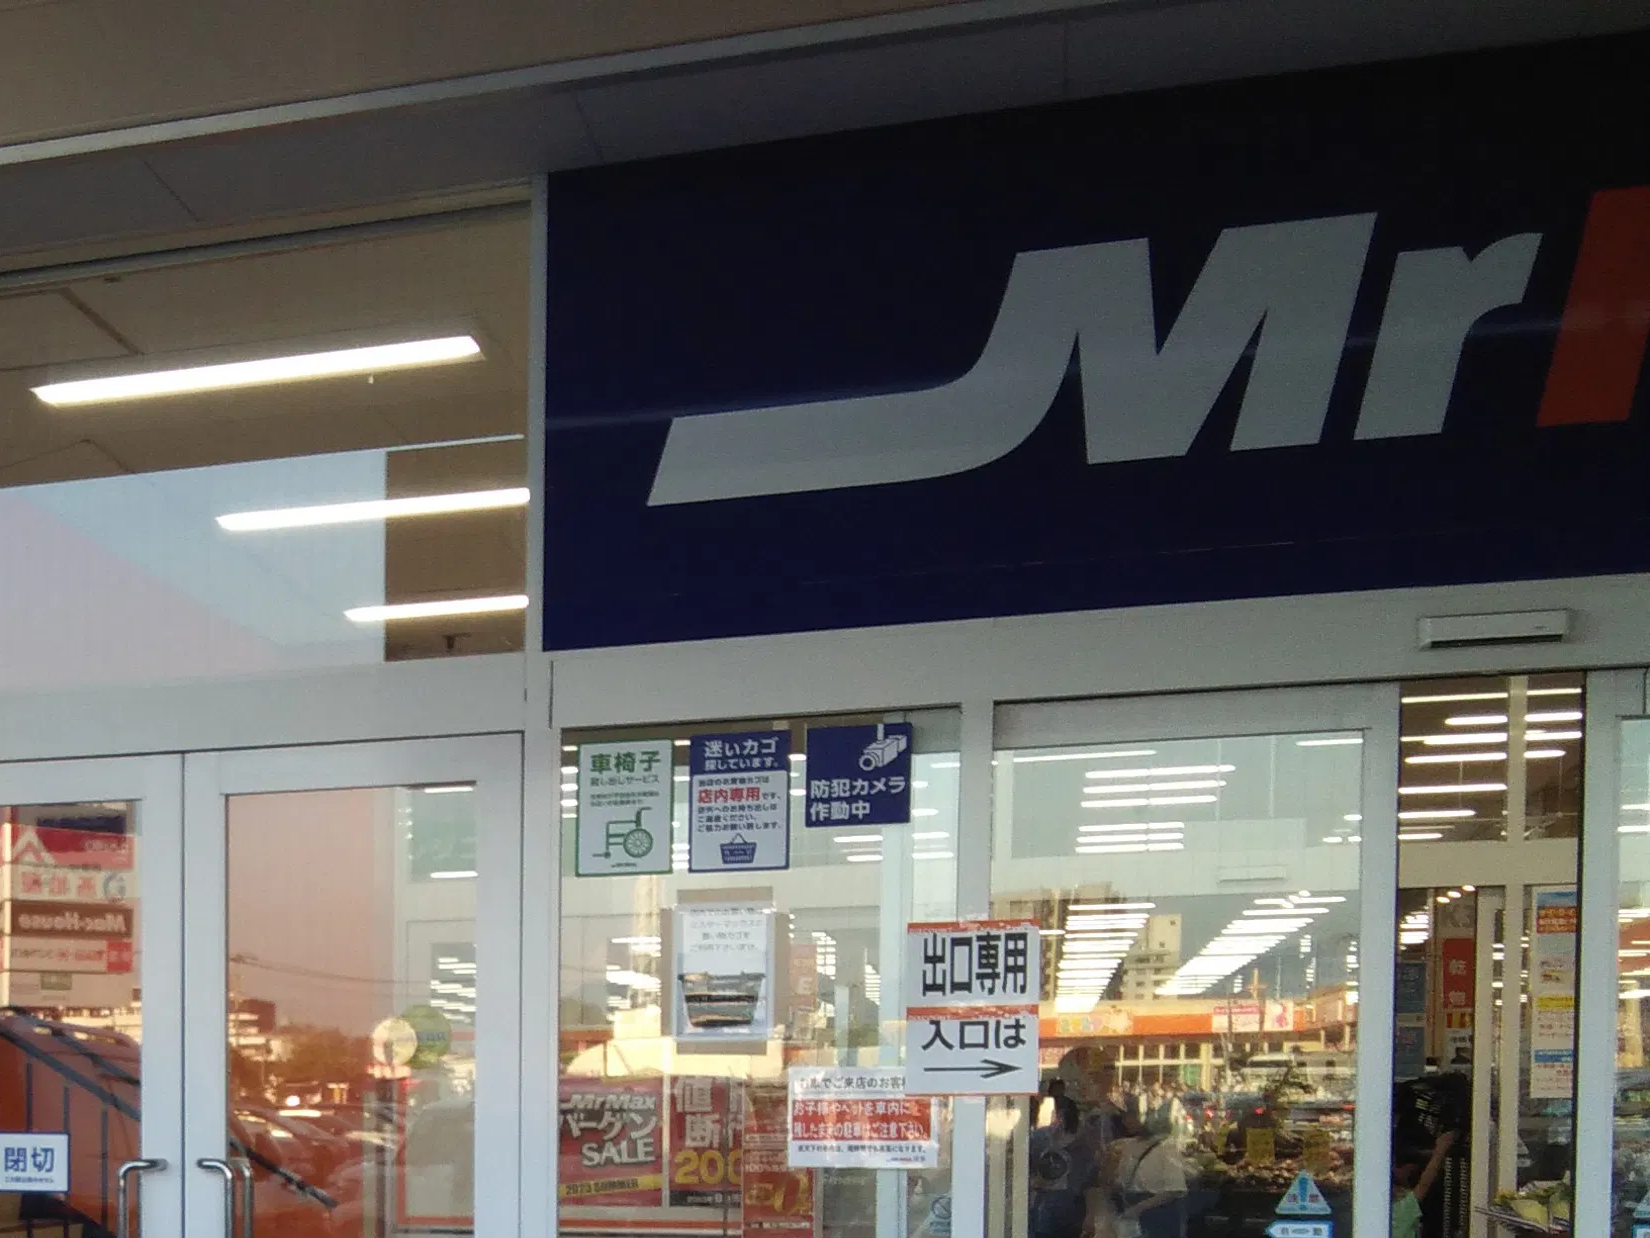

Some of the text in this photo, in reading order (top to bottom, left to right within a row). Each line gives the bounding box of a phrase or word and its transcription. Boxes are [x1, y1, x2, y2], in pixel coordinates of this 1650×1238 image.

[704, 737, 779, 758] 迷いカゴ
[590, 751, 661, 775] 車椅子
[810, 776, 906, 799] 防犯カメラ
[810, 800, 871, 822] 作動中
[922, 931, 1029, 997] 出口専用
[922, 1018, 1026, 1051] 入口は
[559, 1092, 657, 1111] MrMax
[3, 1146, 55, 1173] 閉切
[581, 1137, 656, 1167] SALE
